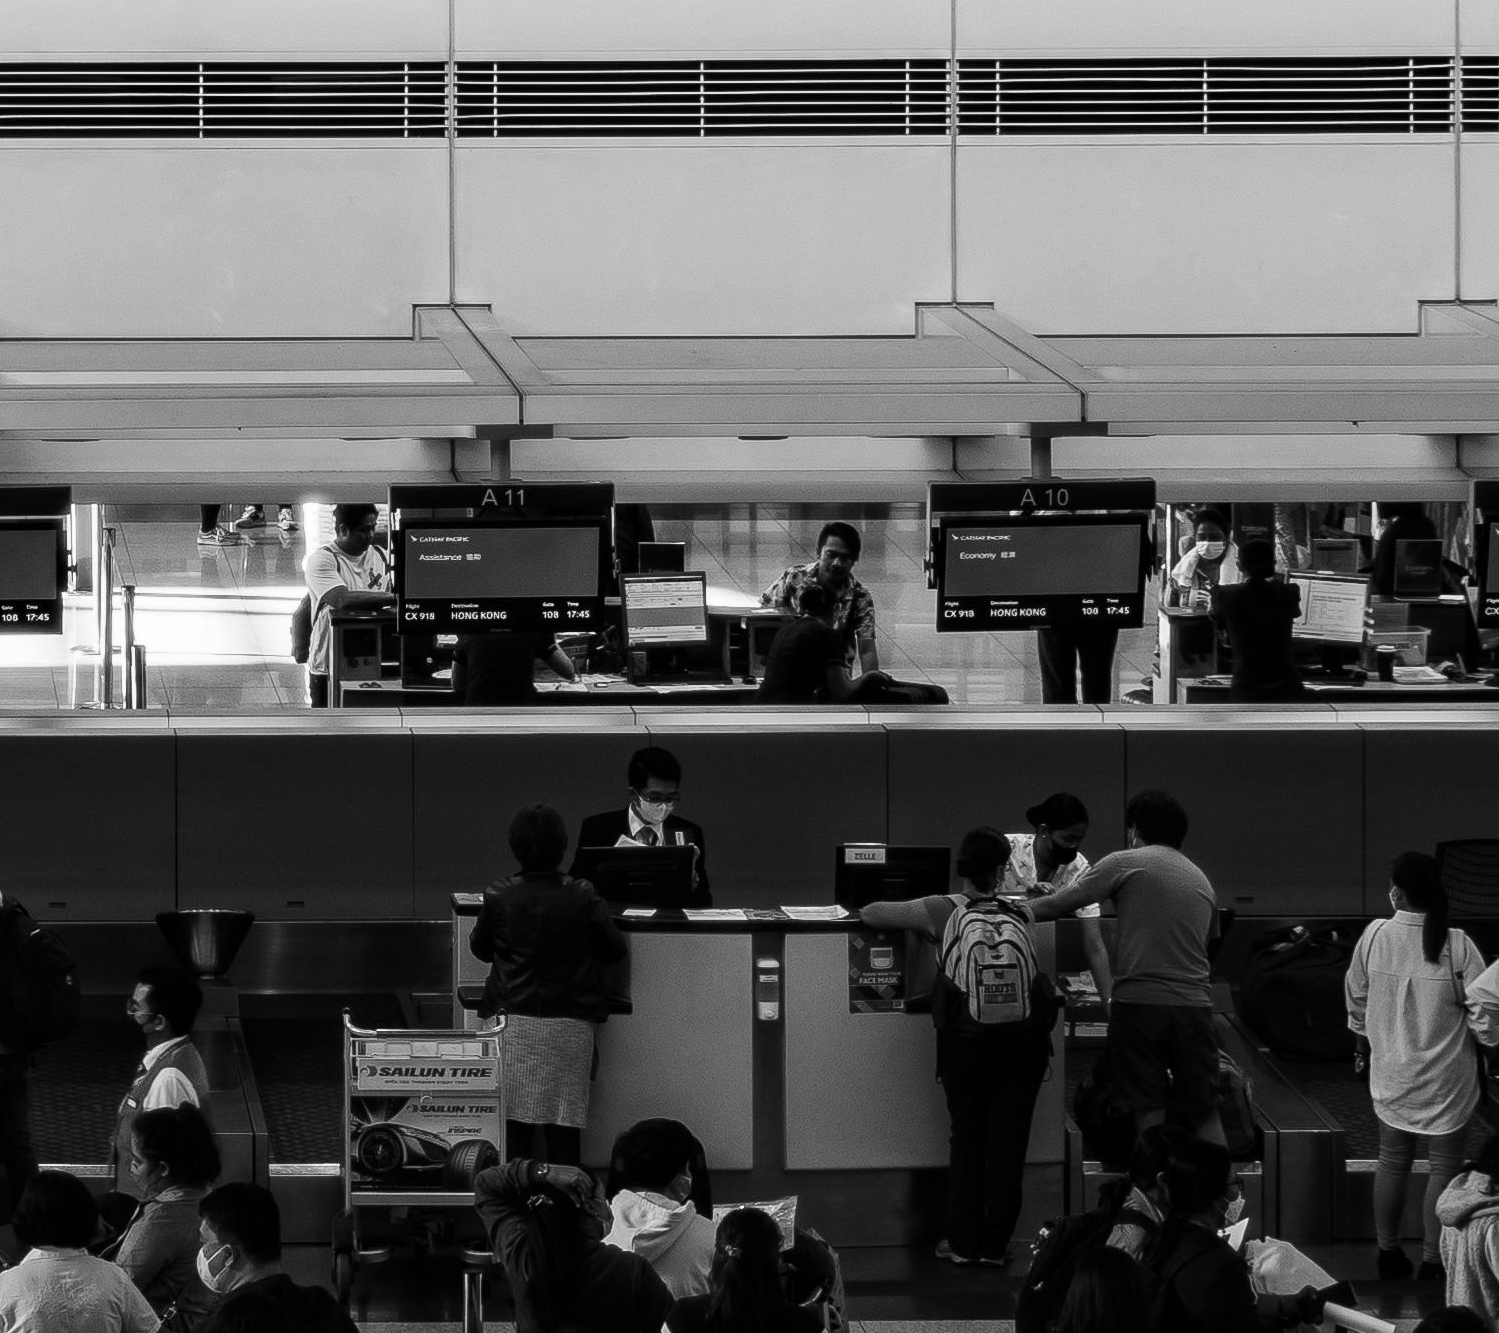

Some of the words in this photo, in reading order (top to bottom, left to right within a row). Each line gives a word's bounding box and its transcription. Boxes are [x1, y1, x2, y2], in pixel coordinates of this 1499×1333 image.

[505, 488, 525, 506] 11
[1044, 488, 1070, 506] 10
[959, 551, 997, 560] Economy
[405, 612, 417, 620] CX
[451, 611, 478, 620] HONG
[480, 611, 507, 620] KONG
[566, 610, 590, 618] 17:45
[944, 609, 957, 618] CX
[990, 608, 1018, 617] HONG
[1019, 608, 1046, 617] KONG
[1106, 606, 1130, 615] 17:45
[25, 613, 50, 622] 17:45
[379, 1067, 446, 1078] SAILUN
[450, 1067, 493, 1078] TIRE
[419, 1105, 465, 1114] SAILUN
[468, 1105, 498, 1114] TIRE
